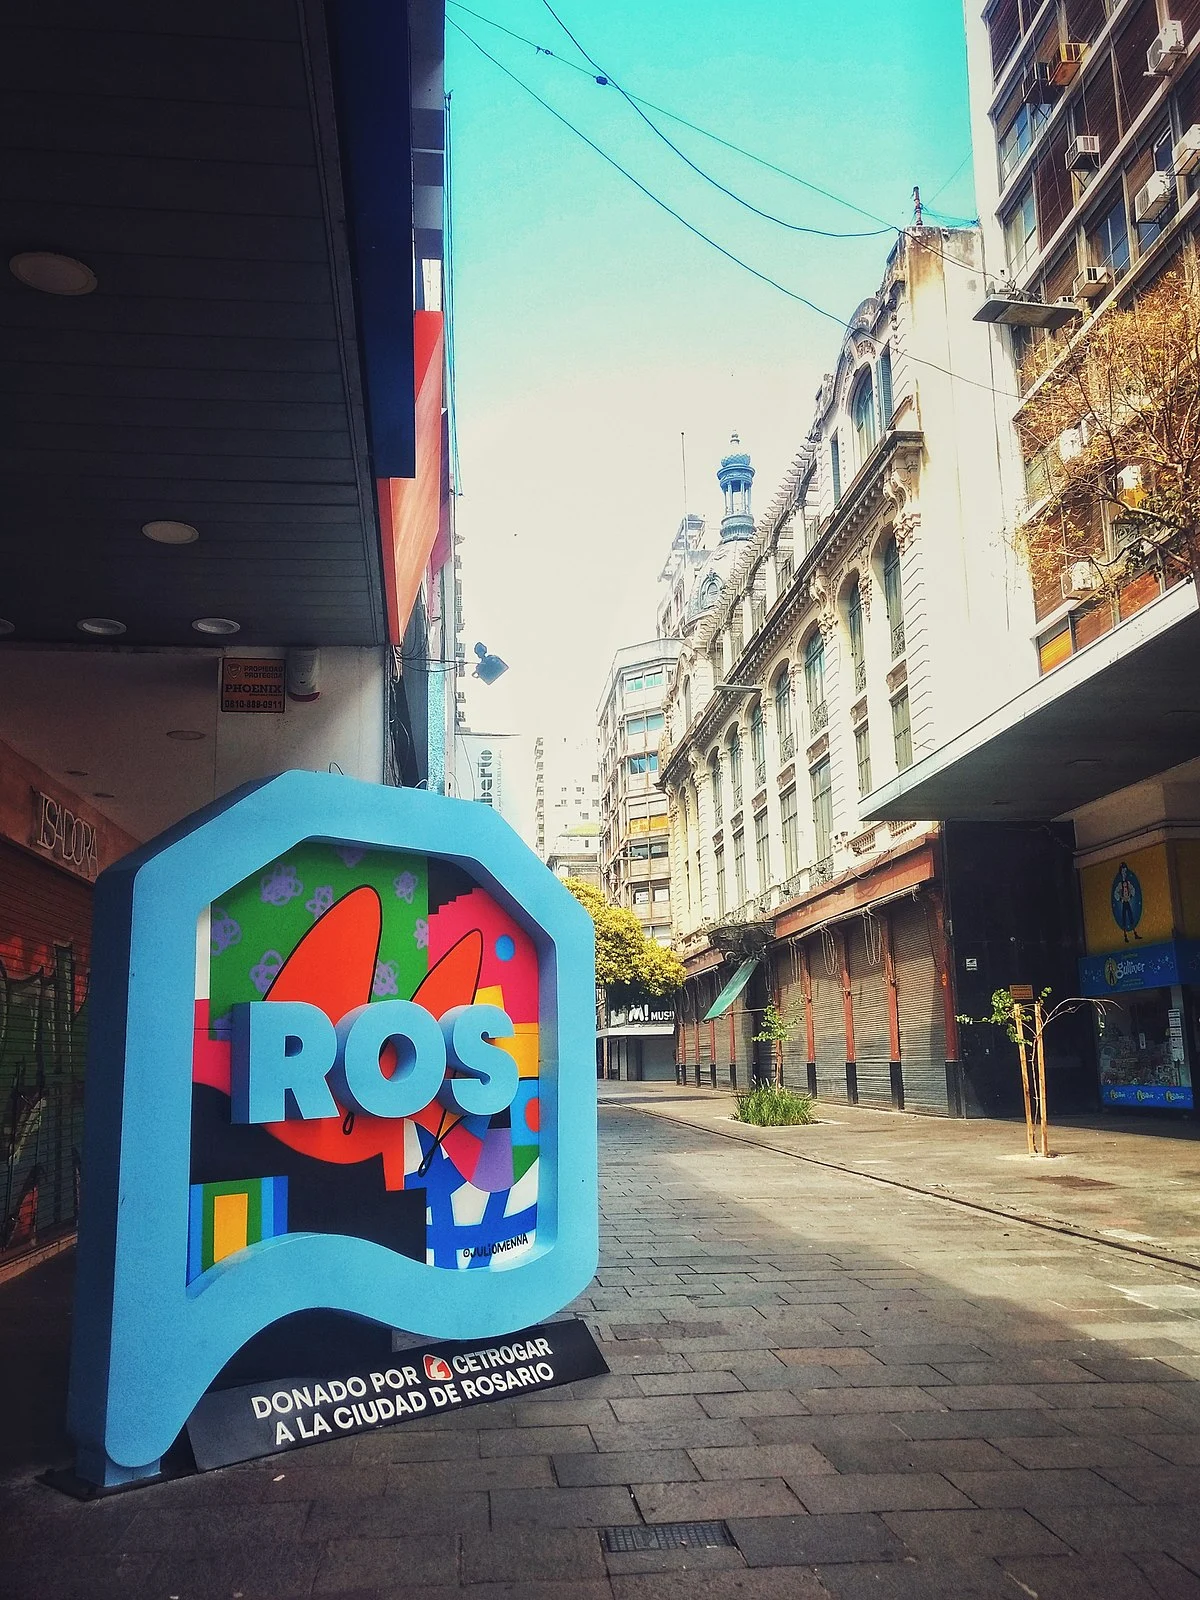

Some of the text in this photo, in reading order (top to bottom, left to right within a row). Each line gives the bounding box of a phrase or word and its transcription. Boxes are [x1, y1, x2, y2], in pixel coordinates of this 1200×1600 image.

[225, 684, 282, 693] PHOENIX
[37, 791, 99, 878] ISADORA
[246, 999, 519, 1124] ROS
[251, 1337, 553, 1419] DONADO POR CETROGAR
[275, 1362, 554, 1445] A LA CIUDAD DE ROSARIO
